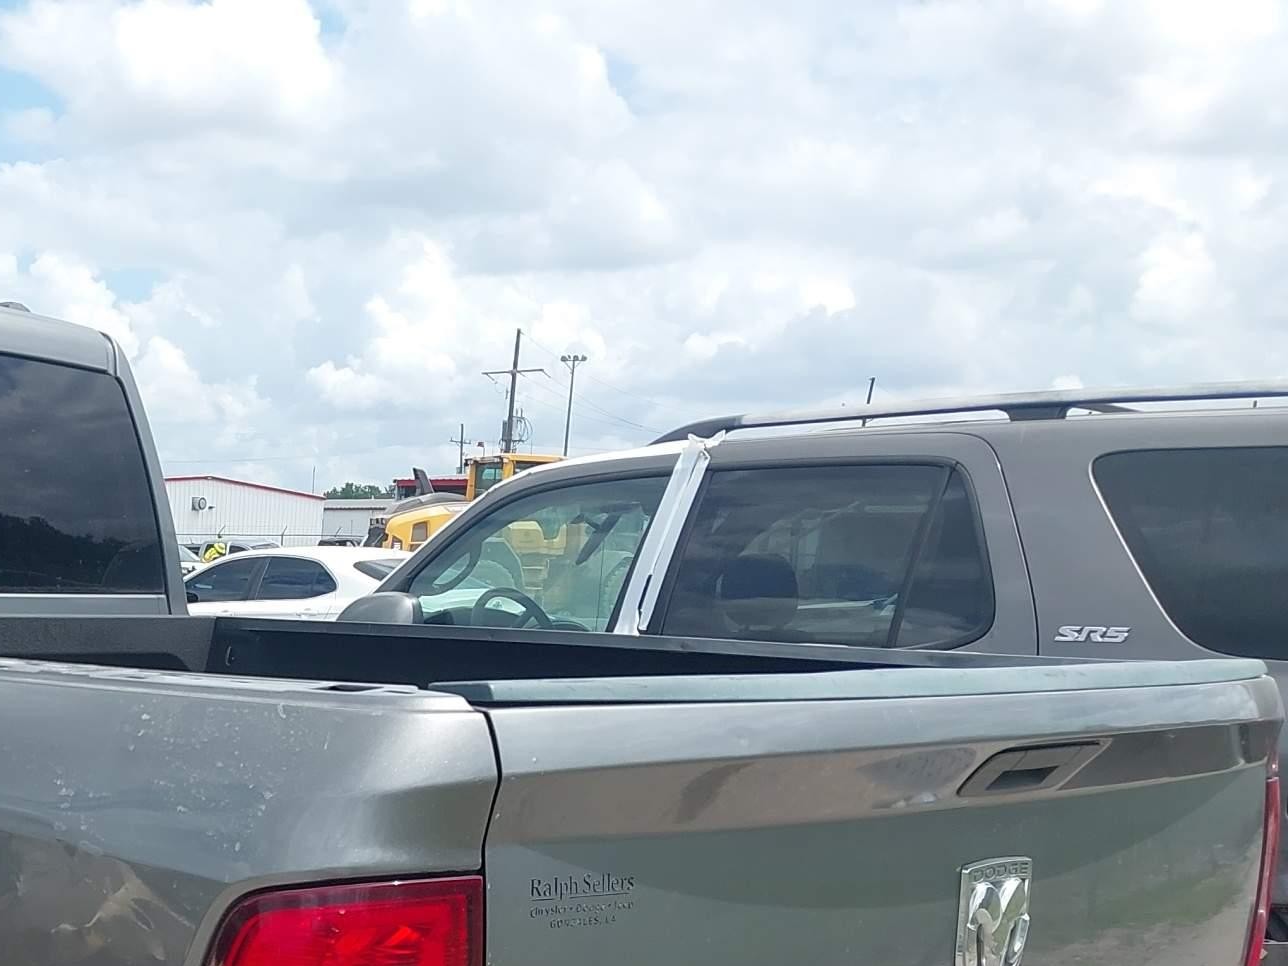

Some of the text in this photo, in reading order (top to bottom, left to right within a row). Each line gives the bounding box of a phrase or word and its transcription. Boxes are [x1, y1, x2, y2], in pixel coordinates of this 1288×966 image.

[1054, 625, 1131, 643] SR5
[970, 861, 1030, 883] DODGE
[531, 872, 634, 900] Ralph Sellers
